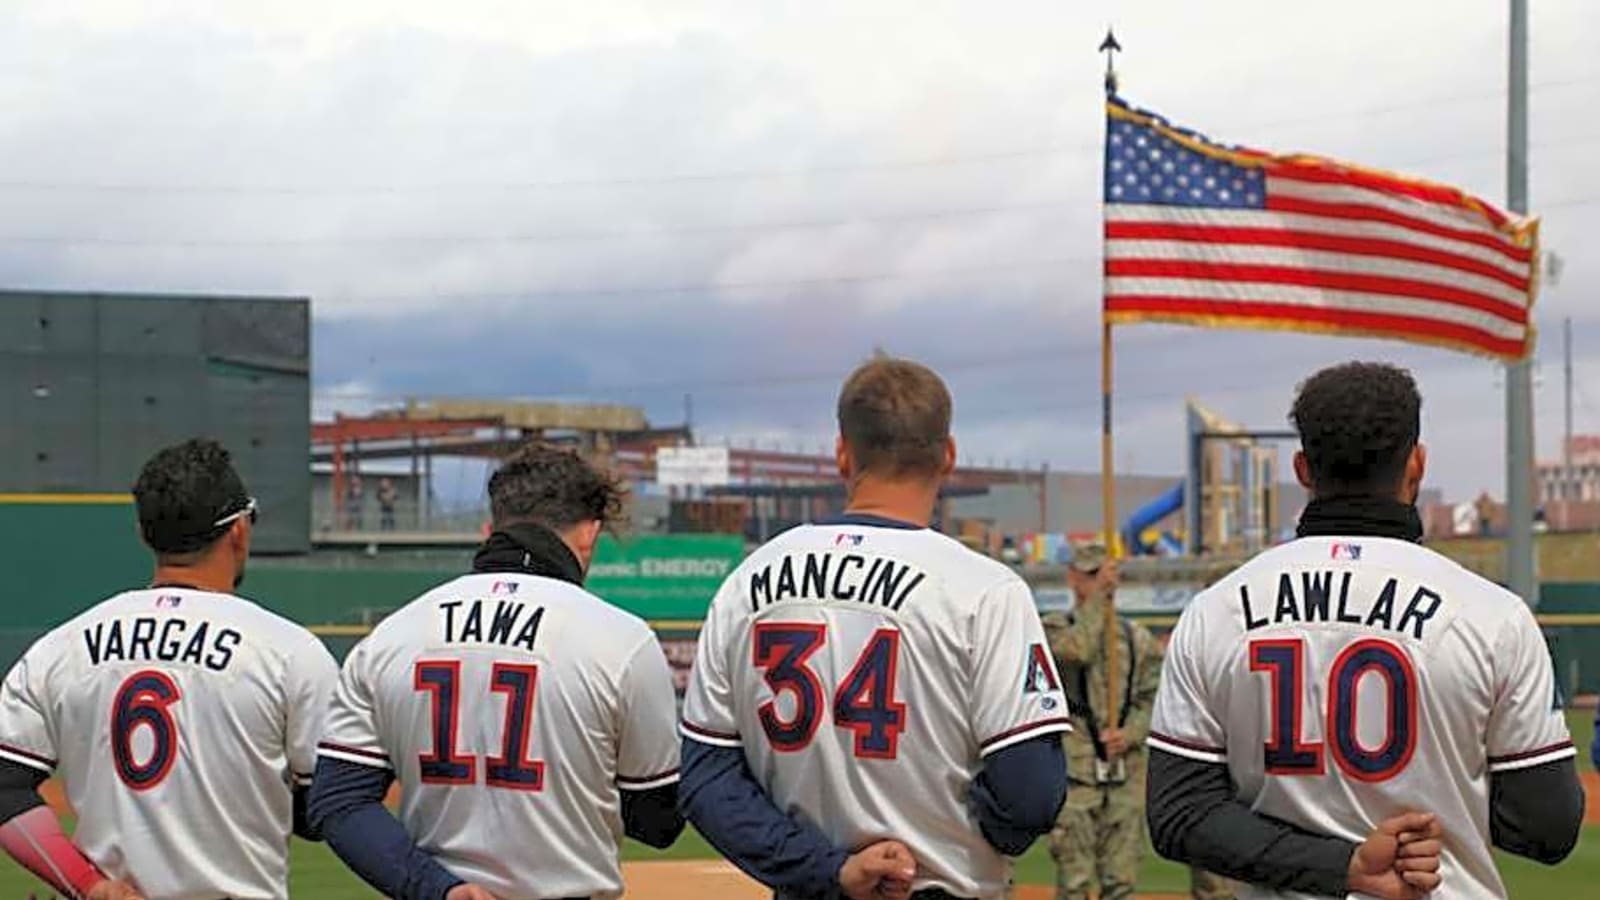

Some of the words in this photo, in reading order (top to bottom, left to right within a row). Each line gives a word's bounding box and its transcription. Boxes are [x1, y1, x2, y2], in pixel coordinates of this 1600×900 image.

[641, 558, 729, 576] ENERGY
[750, 553, 926, 613] MANCINI
[439, 600, 545, 650] TAWA
[1240, 571, 1442, 639] LAWLAR
[84, 618, 242, 671] VARGAS
[752, 622, 906, 760] 34
[1248, 637, 1419, 783] 10
[110, 669, 182, 791] 6
[414, 660, 546, 791] 11
